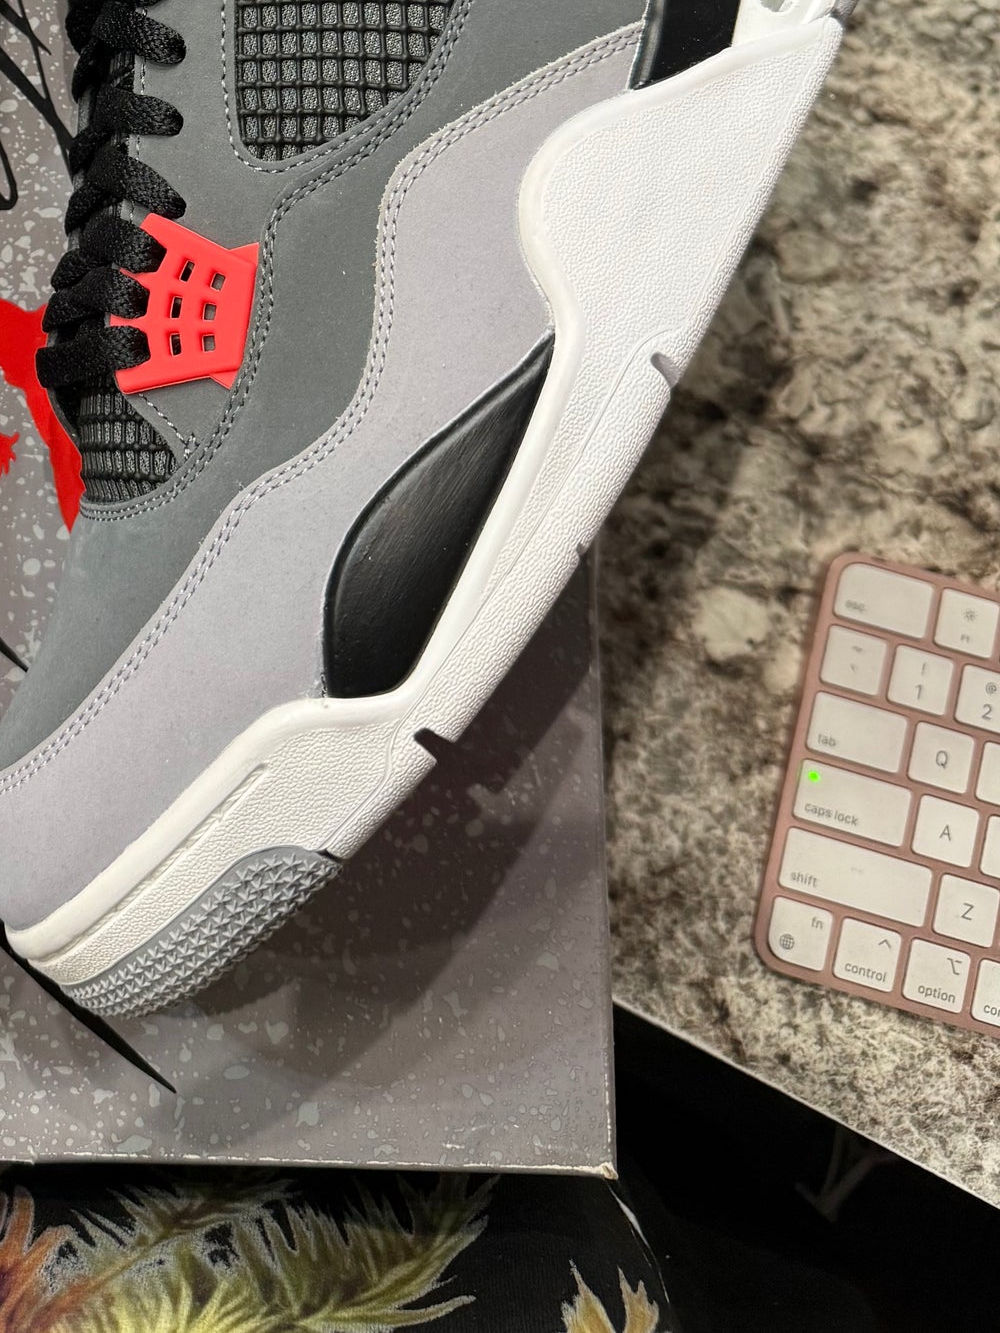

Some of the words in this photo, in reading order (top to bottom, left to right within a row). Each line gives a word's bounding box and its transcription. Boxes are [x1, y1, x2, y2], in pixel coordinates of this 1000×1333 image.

[981, 703, 993, 721] 2
[817, 733, 837, 748] tab
[935, 750, 949, 769] Q
[804, 802, 833, 819] caps
[834, 810, 859, 827] lock
[939, 824, 953, 842] A
[790, 869, 819, 888] shift
[960, 902, 975, 921] Z
[811, 916, 824, 930] fn
[844, 962, 888, 983] control
[918, 984, 957, 1004] option
